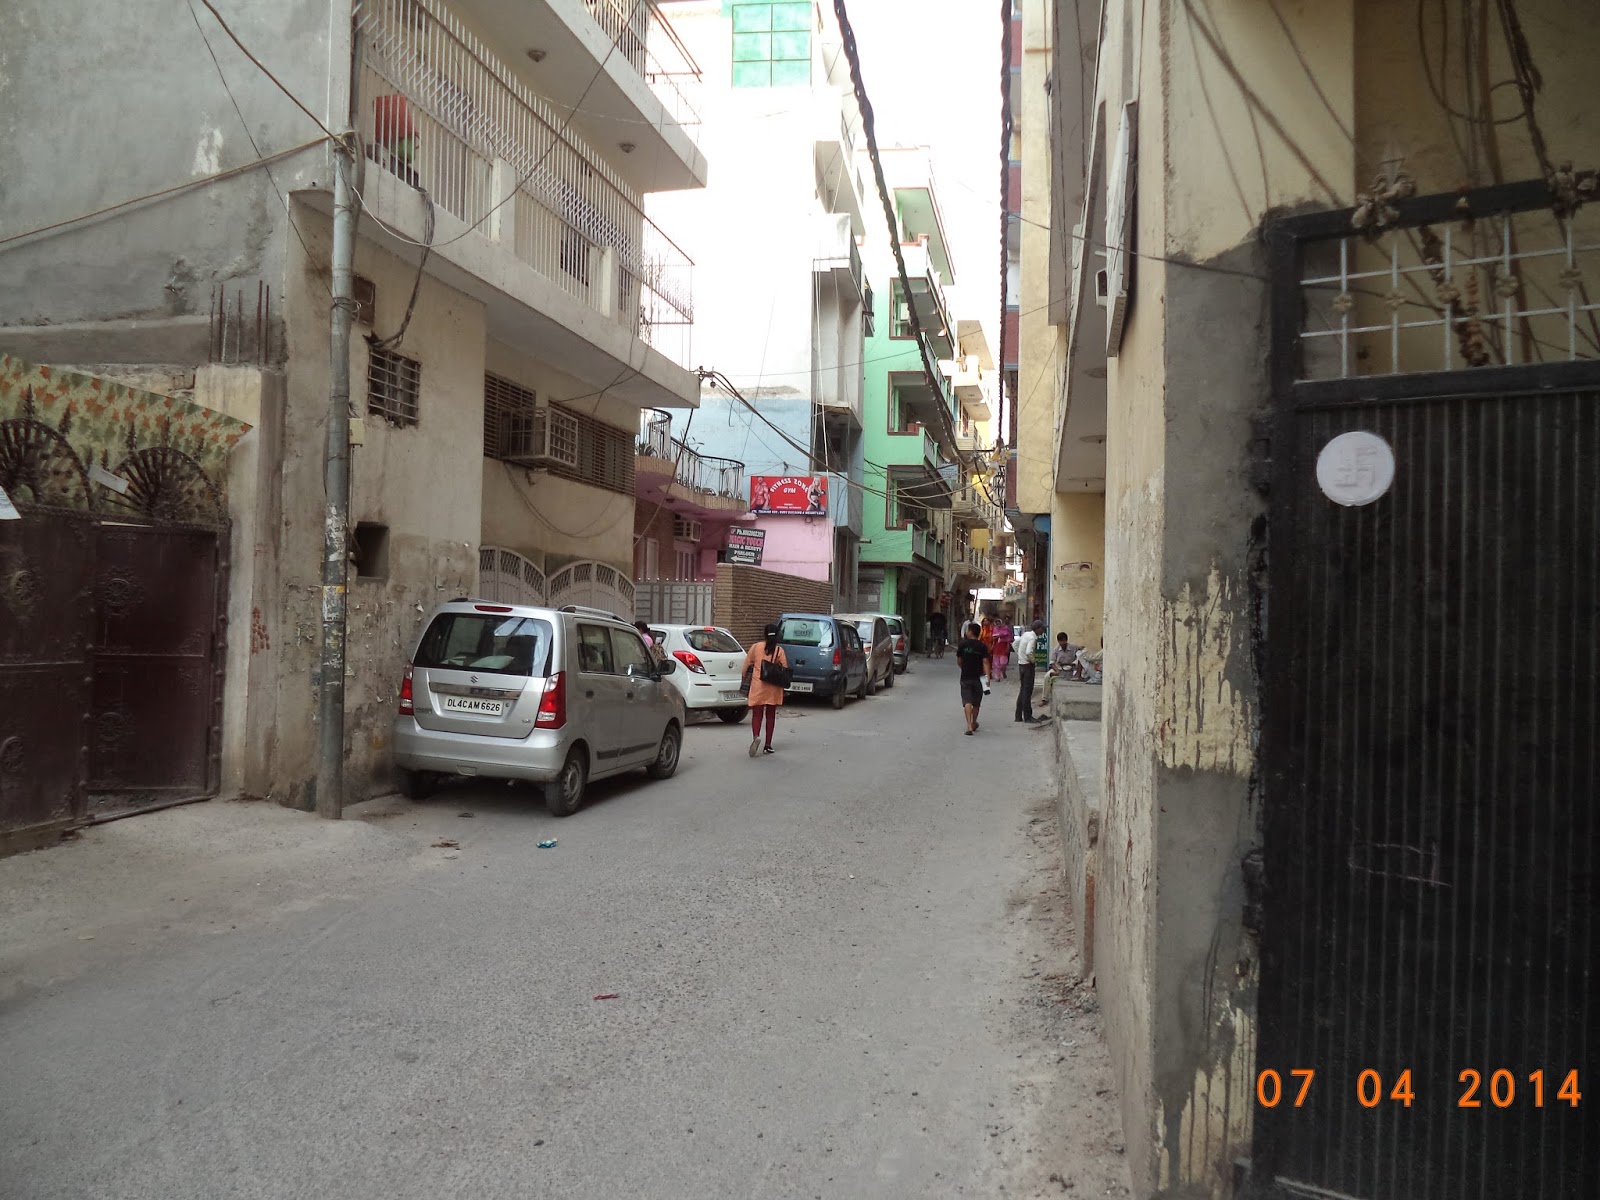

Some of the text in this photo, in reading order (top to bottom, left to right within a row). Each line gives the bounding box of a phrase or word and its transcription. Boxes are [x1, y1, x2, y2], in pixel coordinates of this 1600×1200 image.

[770, 478, 809, 493] FITNESS ZONE
[730, 535, 764, 547] MAGIC TOUCH
